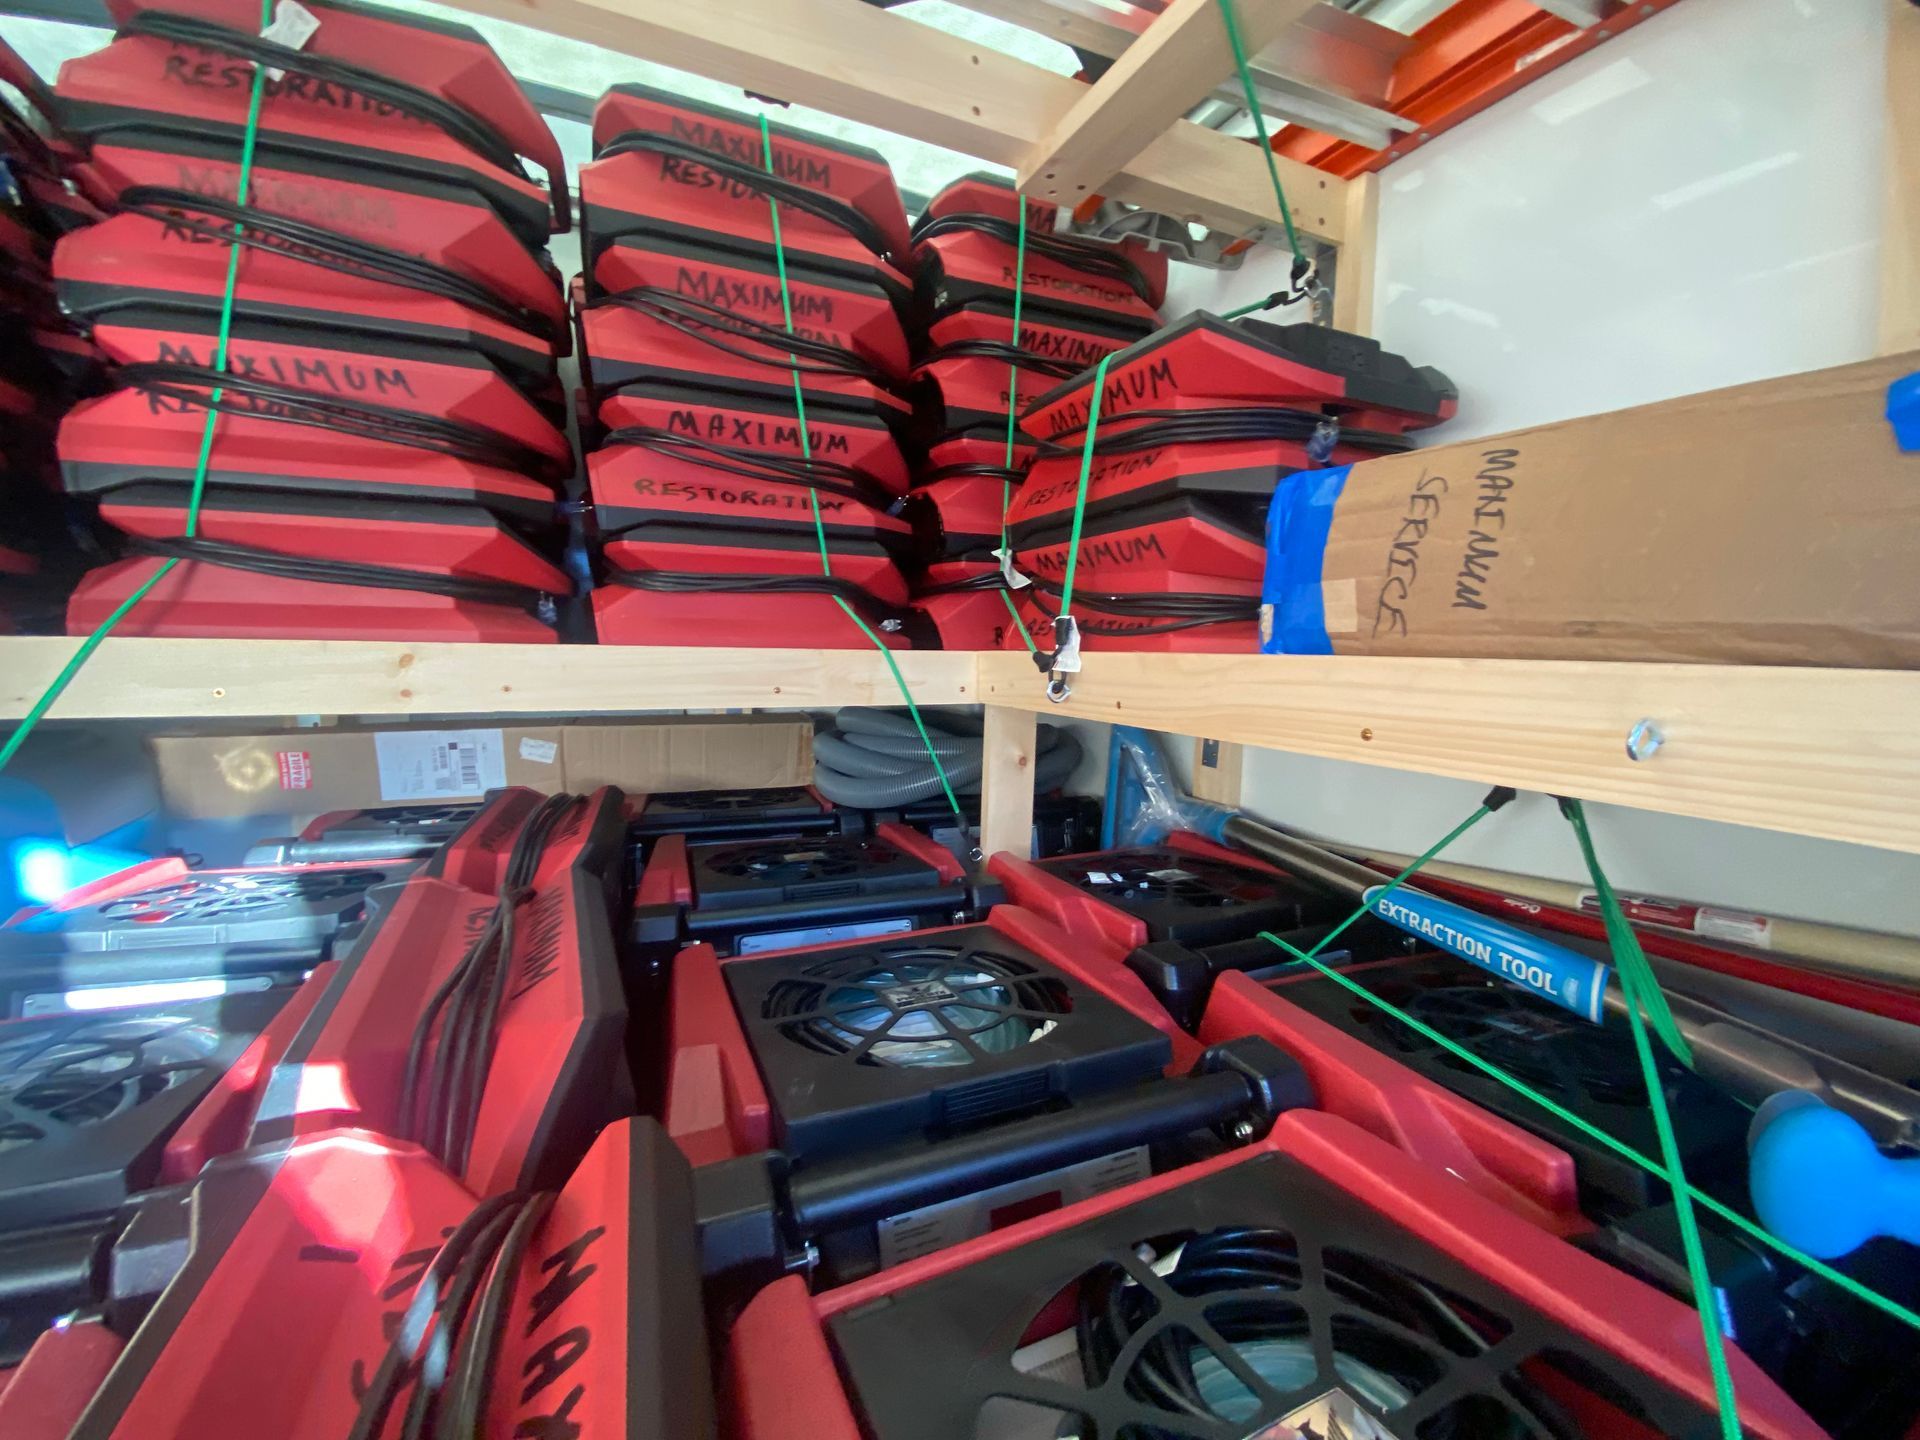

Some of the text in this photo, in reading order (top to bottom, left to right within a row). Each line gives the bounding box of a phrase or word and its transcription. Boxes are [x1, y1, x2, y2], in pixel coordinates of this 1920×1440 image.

[677, 266, 833, 323] MAXIMUM
[667, 411, 848, 454] MAXIMUM
[1371, 467, 1448, 639] SERVICE
[1378, 898, 1559, 996] EXTRACTION TOOL
